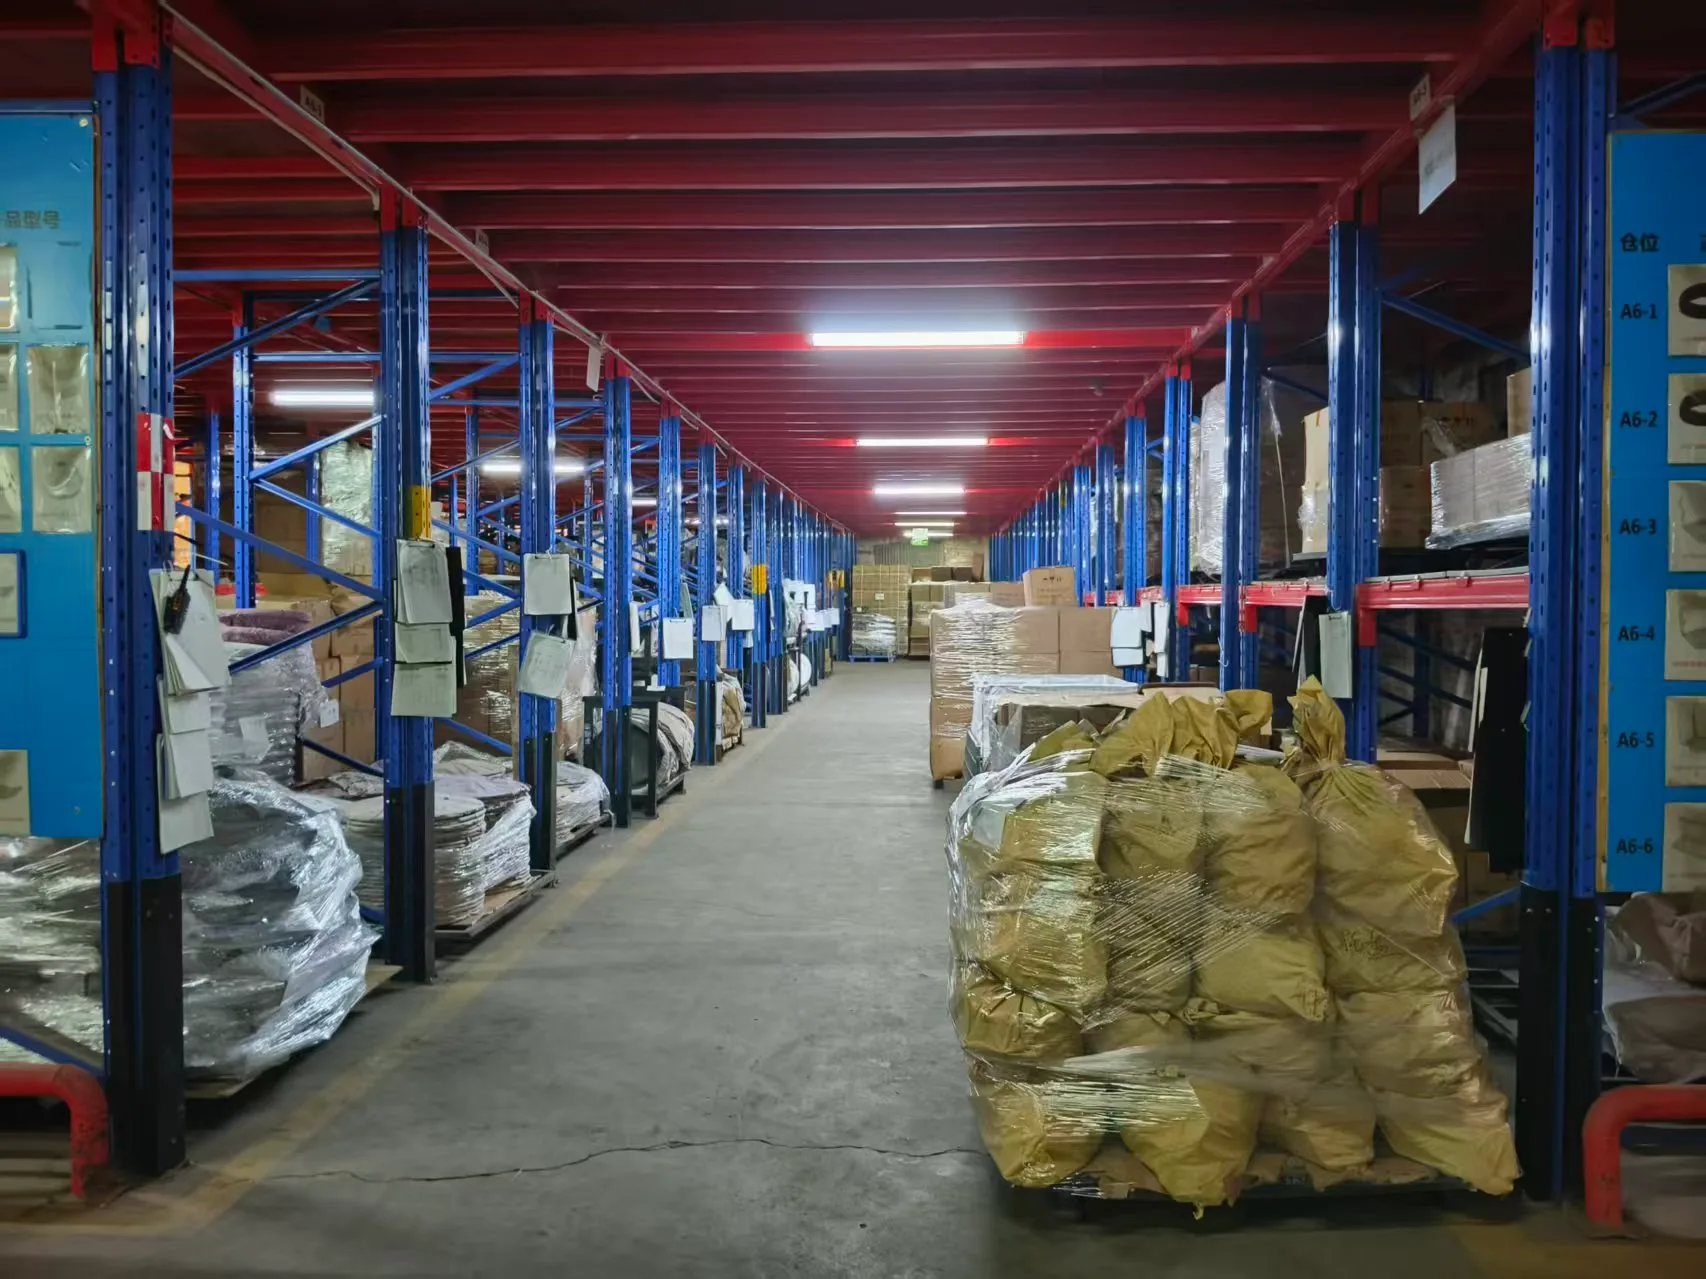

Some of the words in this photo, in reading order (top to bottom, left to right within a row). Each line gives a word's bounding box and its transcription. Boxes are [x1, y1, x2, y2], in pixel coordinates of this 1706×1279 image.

[0, 210, 61, 229] 品型号
[1619, 232, 1659, 253] 仓位
[1619, 302, 1658, 320] A6-1
[1619, 410, 1658, 428] A6-2
[1618, 518, 1657, 535] A6-3
[1617, 625, 1655, 642] A6-4
[1616, 731, 1655, 749] A6-5
[1615, 837, 1655, 855] A6-6
